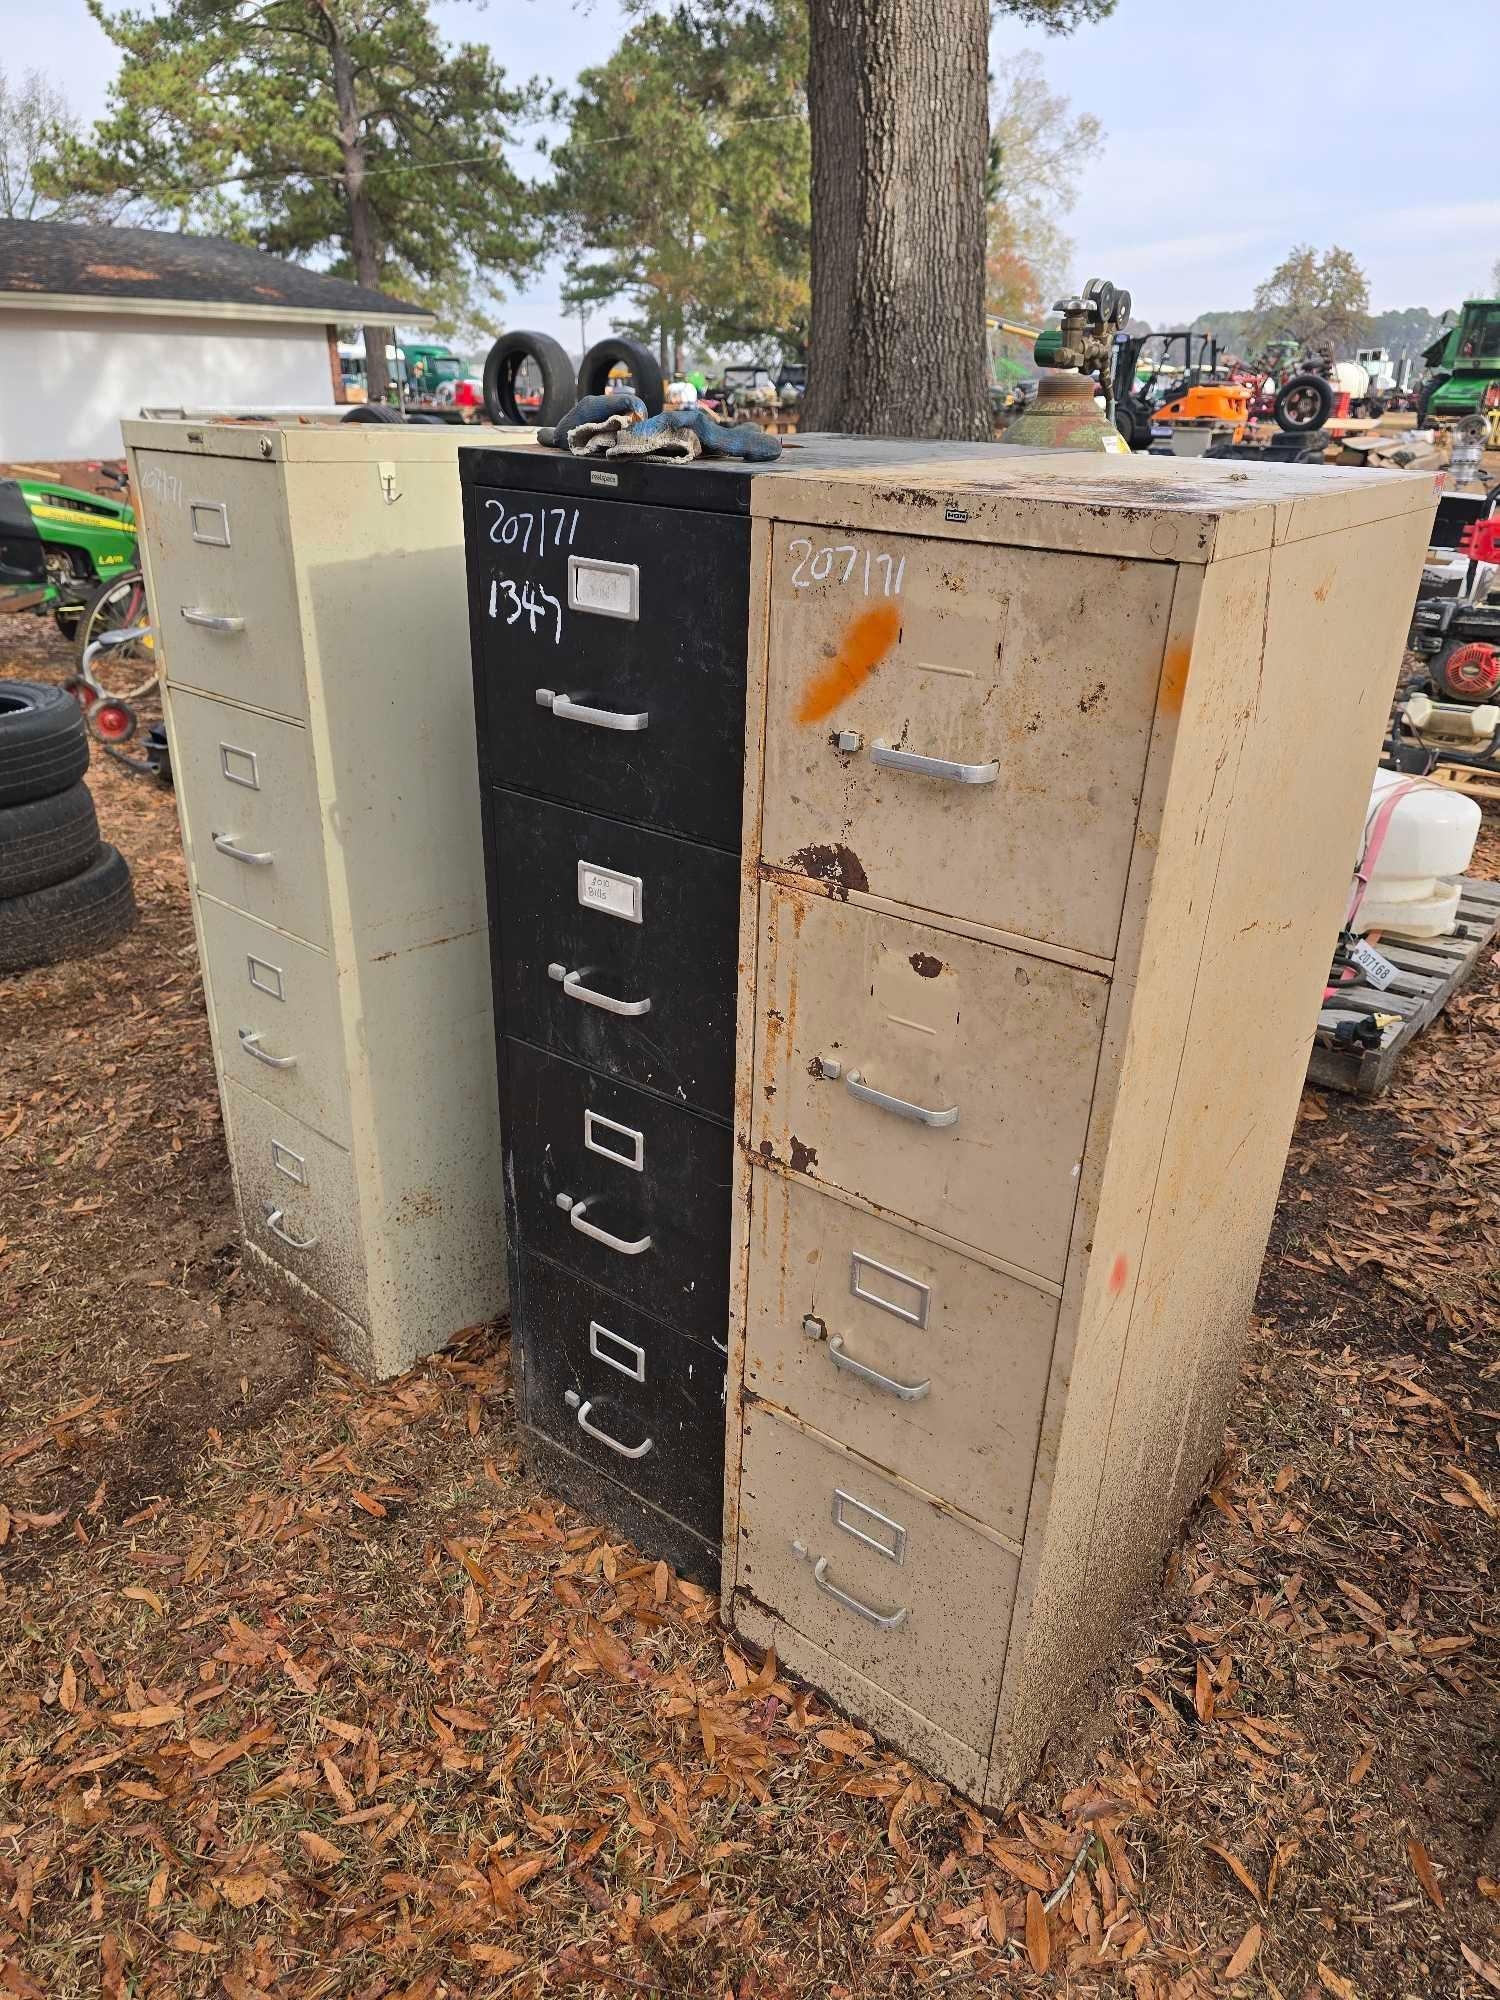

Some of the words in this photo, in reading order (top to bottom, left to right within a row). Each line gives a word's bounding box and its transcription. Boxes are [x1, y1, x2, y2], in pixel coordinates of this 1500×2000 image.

[485, 500, 580, 557] 207171
[789, 539, 906, 597] 207171
[1359, 950, 1391, 980] 207168
